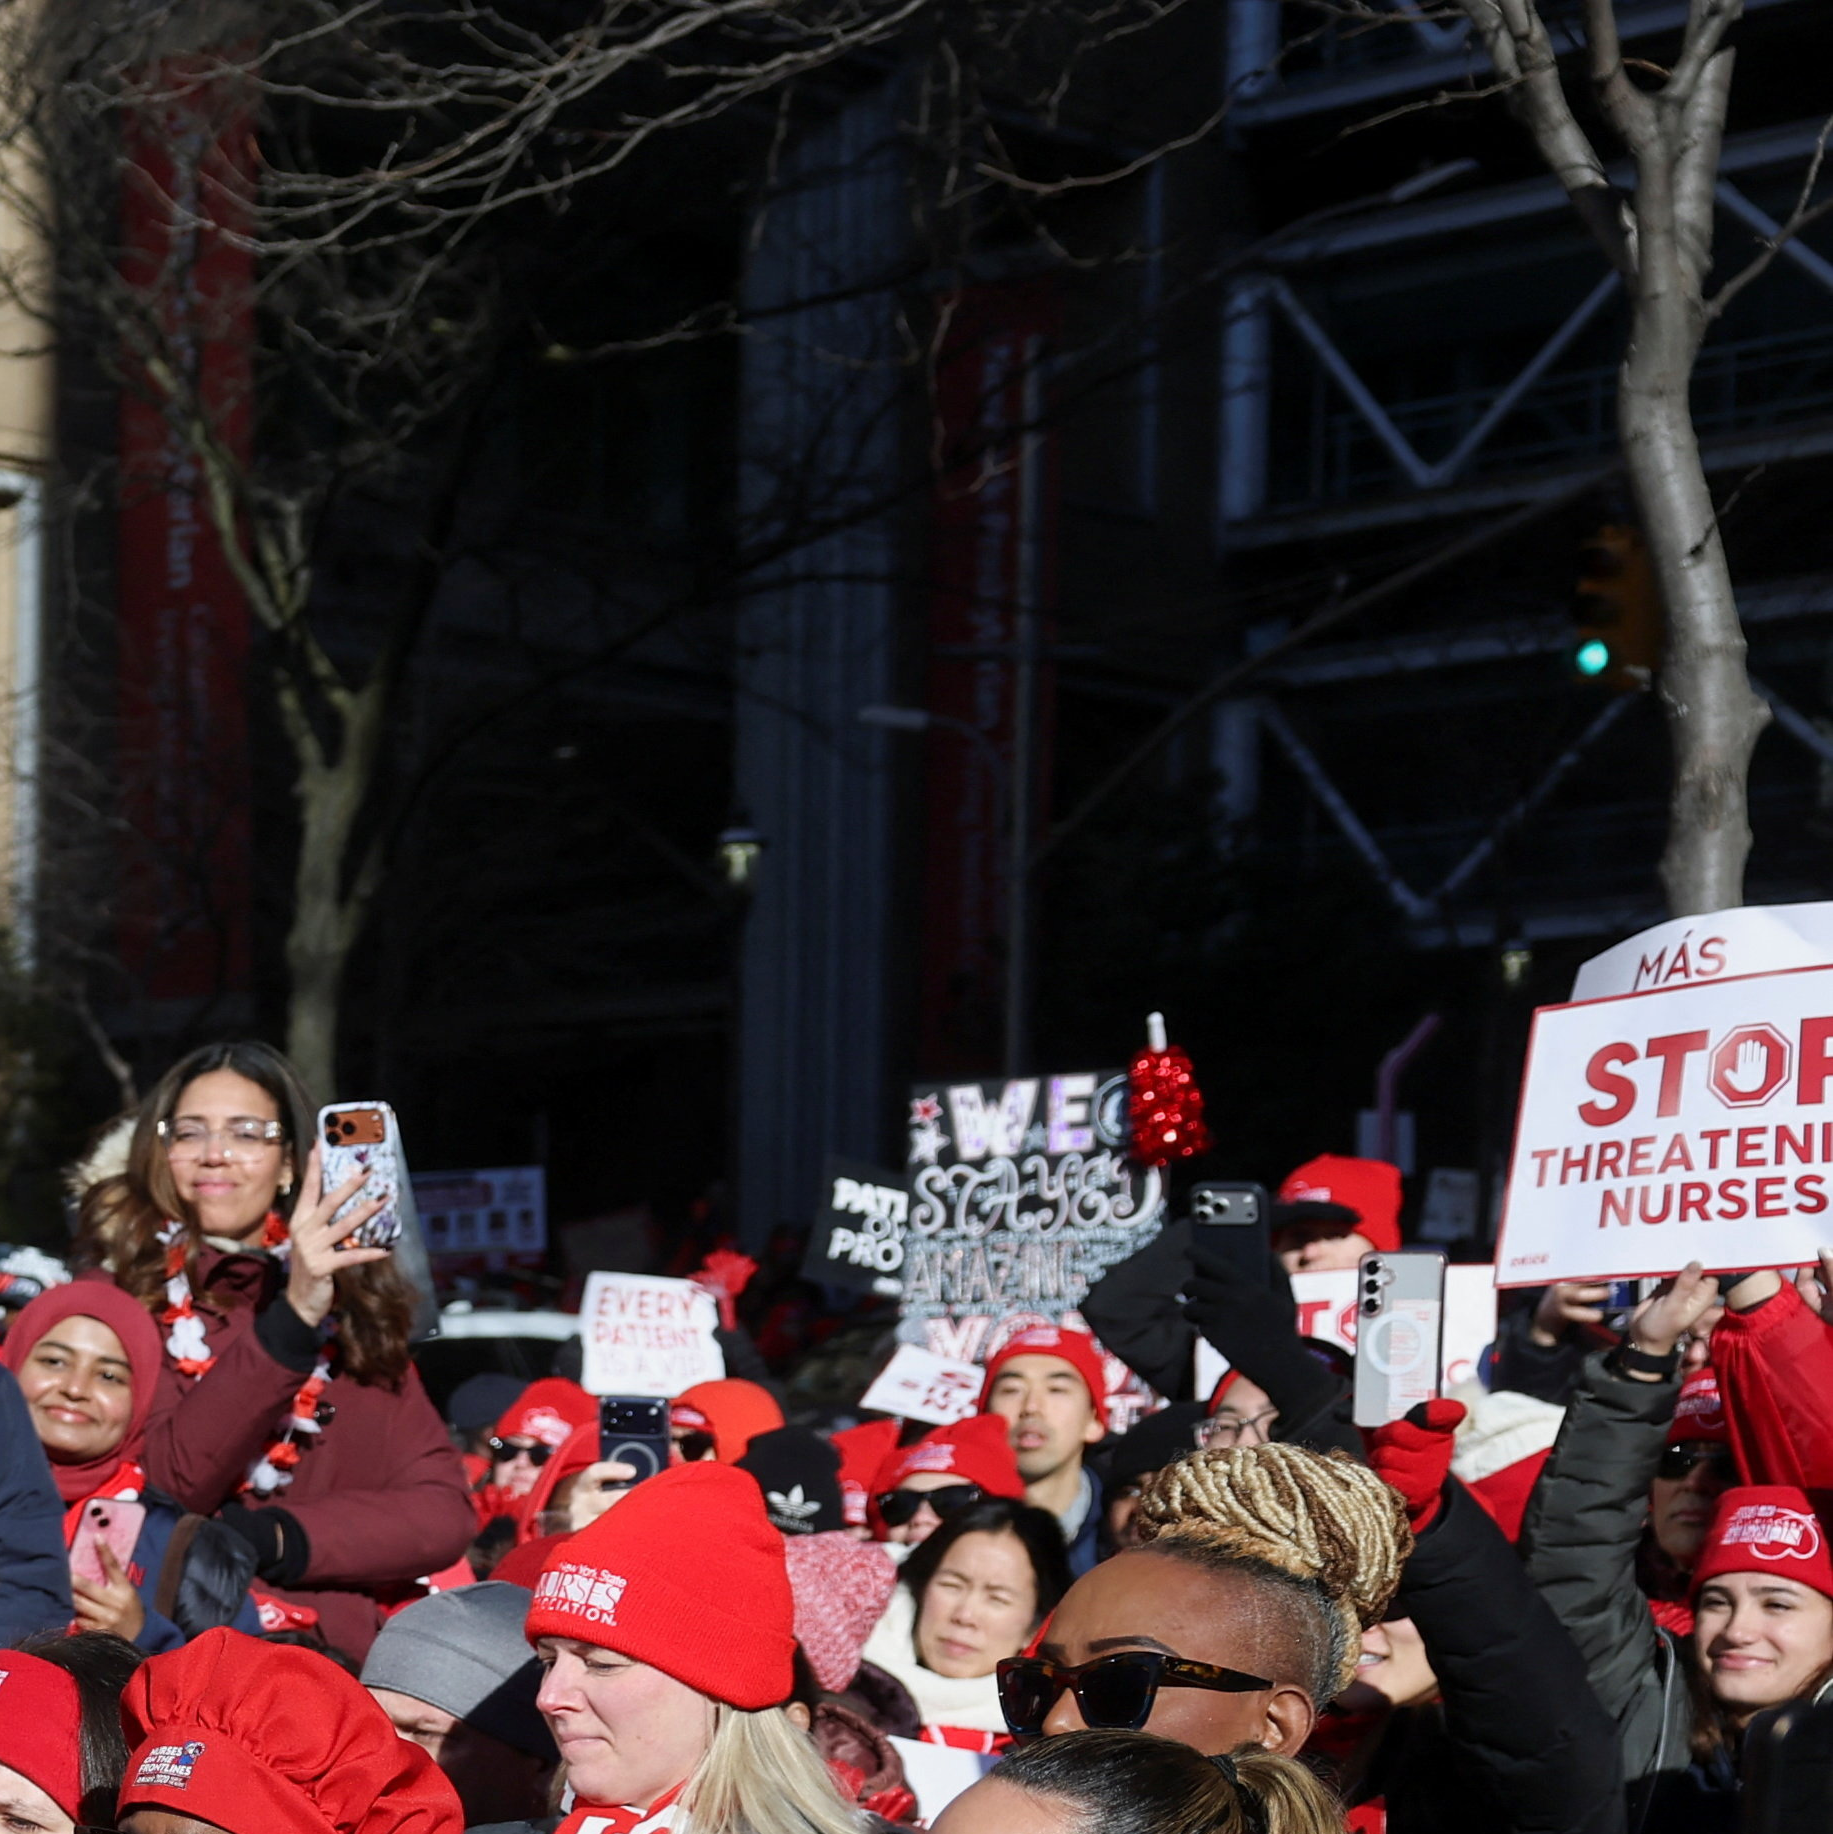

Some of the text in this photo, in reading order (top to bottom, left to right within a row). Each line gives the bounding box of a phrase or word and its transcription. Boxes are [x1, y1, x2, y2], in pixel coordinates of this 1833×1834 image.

[1598, 1173, 1830, 1230] NURSES
[596, 1285, 698, 1320] EVERY
[594, 1320, 701, 1350] PATIENT
[598, 1568, 628, 1589] State
[148, 1745, 184, 1757] NURSES
